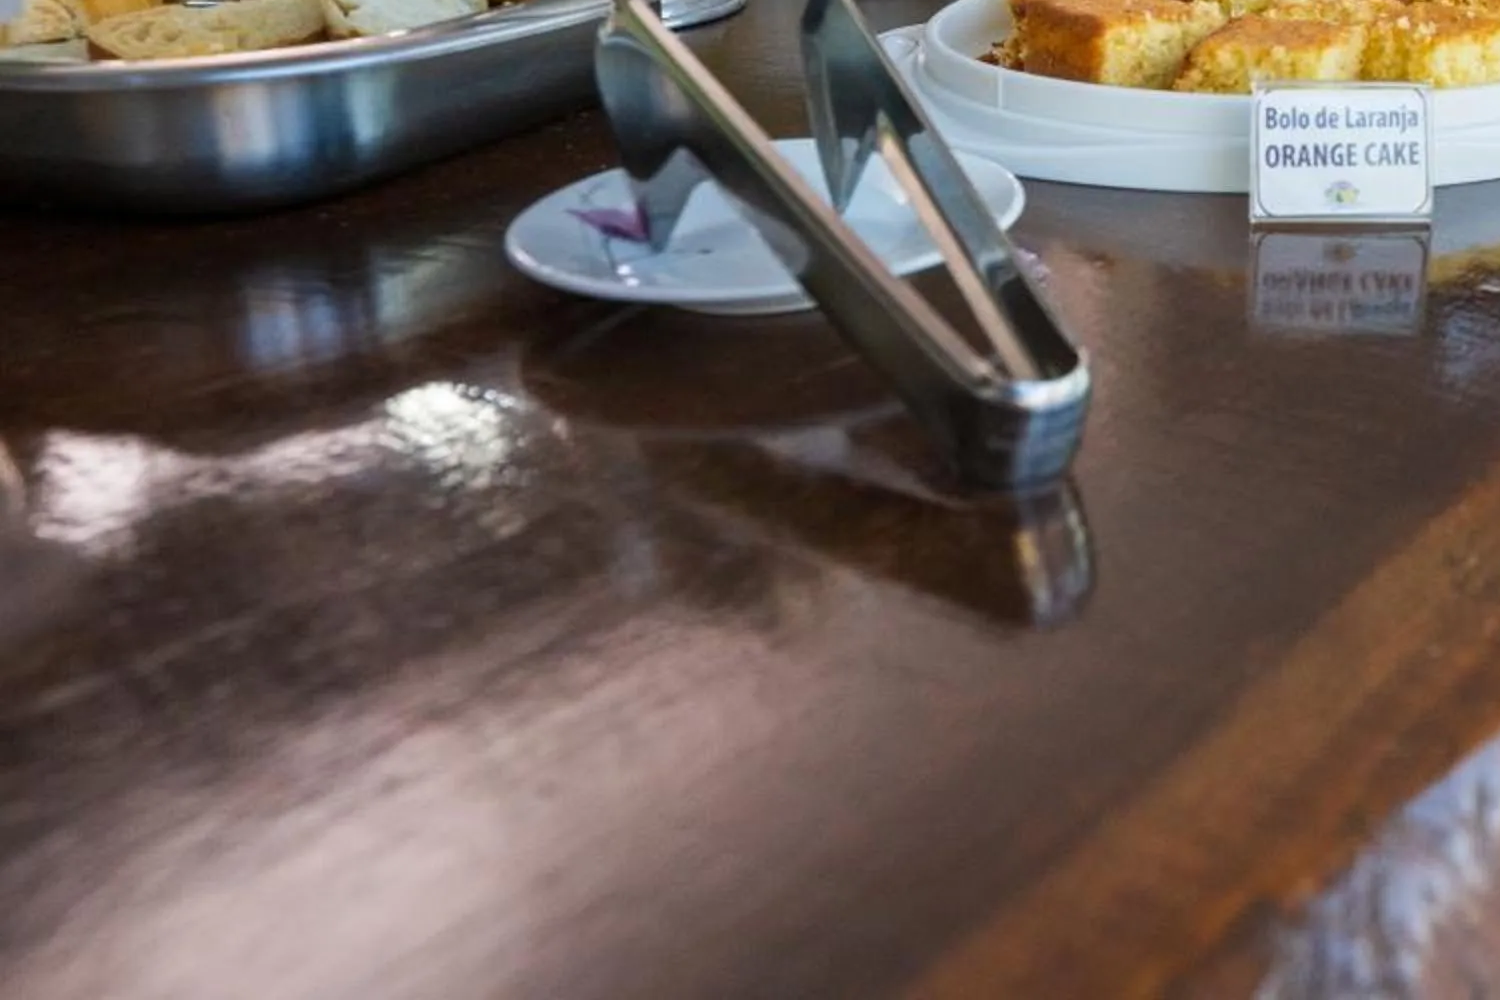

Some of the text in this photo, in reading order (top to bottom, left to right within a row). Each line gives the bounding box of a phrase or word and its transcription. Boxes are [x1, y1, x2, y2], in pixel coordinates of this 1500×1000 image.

[1265, 104, 1419, 133] Bolo de Laranja
[1265, 141, 1420, 168] ORANGE CAKE
